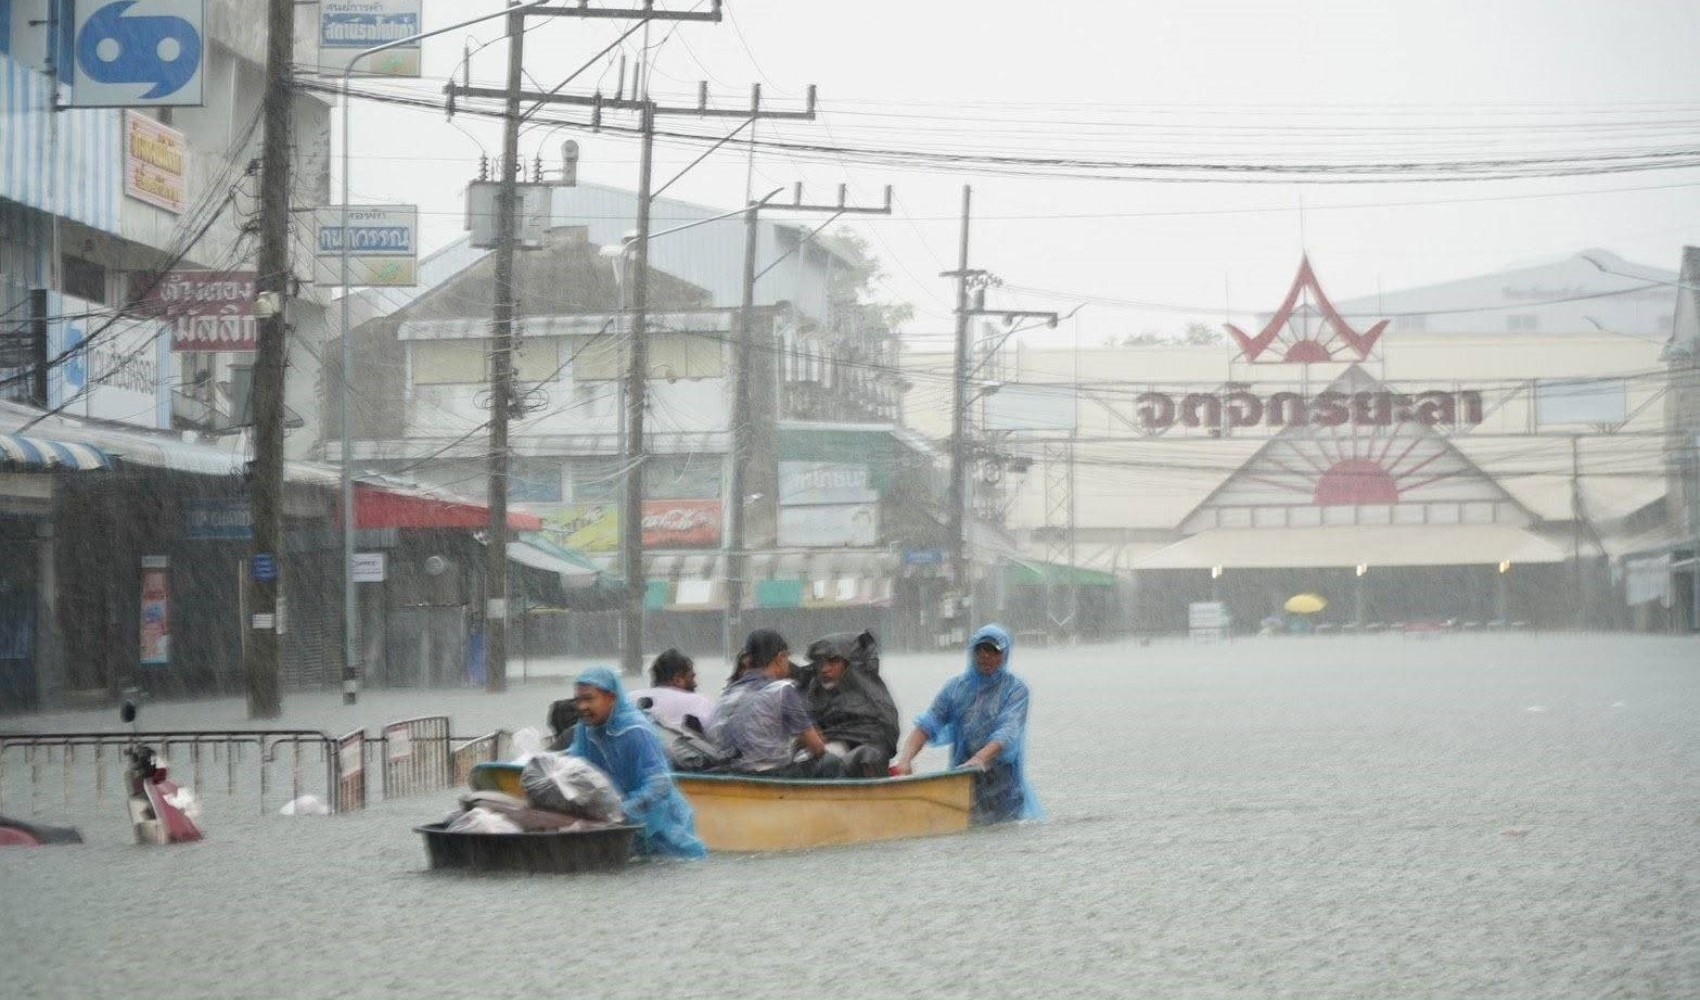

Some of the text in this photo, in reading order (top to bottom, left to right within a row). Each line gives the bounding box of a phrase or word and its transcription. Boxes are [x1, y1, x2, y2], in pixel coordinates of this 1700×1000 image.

[1136, 382, 1483, 437] จตุจักรยะลา
